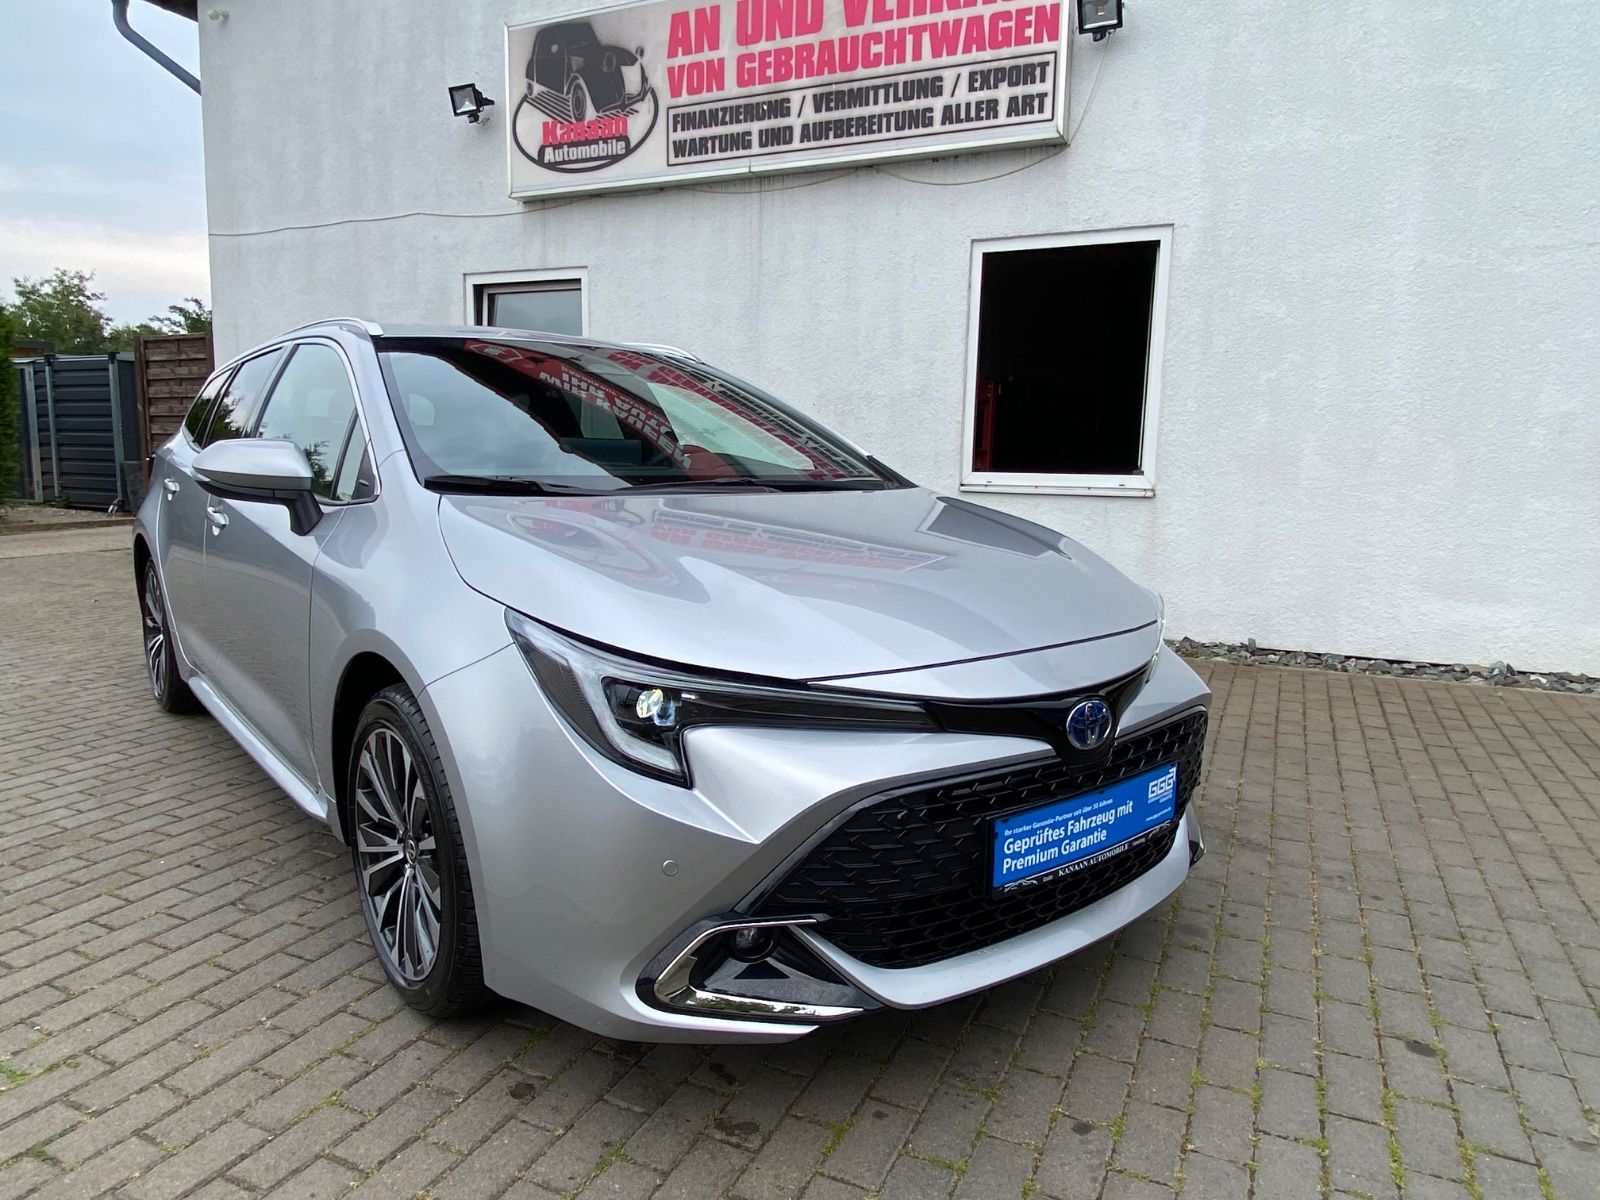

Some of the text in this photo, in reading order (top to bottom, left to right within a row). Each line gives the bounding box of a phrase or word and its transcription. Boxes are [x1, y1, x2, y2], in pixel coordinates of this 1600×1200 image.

[667, 5, 721, 59] AN
[736, 0, 824, 46] UND
[667, 58, 725, 99] VON
[736, 3, 1061, 88] GEBRAUCHTWAGEN
[672, 98, 791, 132] FINANZIERUNG
[813, 75, 944, 114] VERMITTLUNG
[968, 61, 1050, 93] EXPORT
[542, 115, 628, 146] Kanaan
[672, 92, 1048, 158] WARTUNG UND AUFBEREITUNG ALLER ART
[543, 139, 627, 164] Automobile
[1148, 772, 1174, 799] GGG
[1002, 828, 1107, 875] Premium Garantie
[1004, 826, 1065, 855] Geprüftes
[1067, 807, 1116, 836] Fahrzeug
[1117, 800, 1134, 817] mit
[1058, 860, 1089, 877] KANAAN
[1088, 842, 1130, 866] AUTOMOBILE
